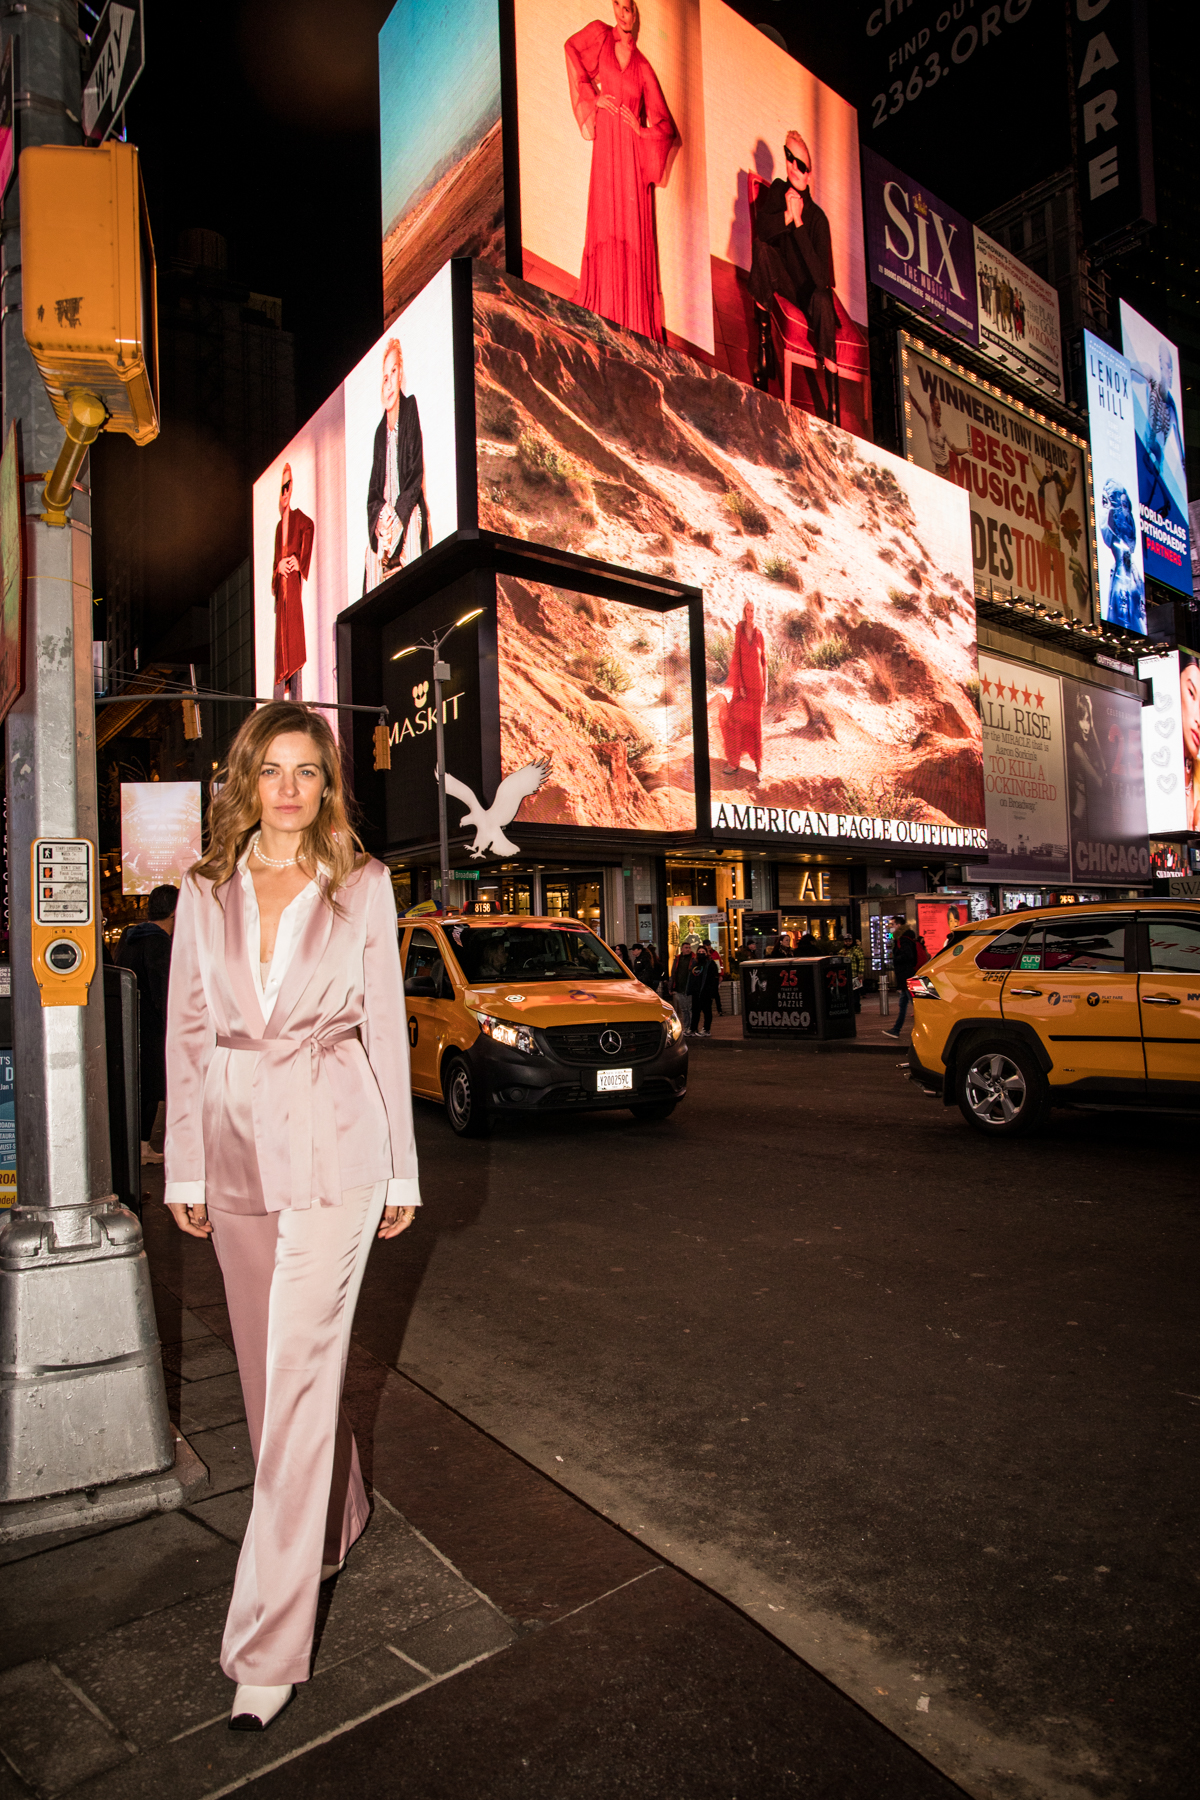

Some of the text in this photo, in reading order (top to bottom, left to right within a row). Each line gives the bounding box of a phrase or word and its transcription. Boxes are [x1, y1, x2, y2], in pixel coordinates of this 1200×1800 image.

[888, 0, 976, 73] FIND OU
[95, 13, 124, 111] WAY
[883, 181, 966, 300] SIX
[903, 262, 918, 283] THE
[920, 273, 952, 305] MUSICAL
[1028, 299, 1055, 325] THE PLAY
[1041, 319, 1059, 341] GOES
[1027, 321, 1059, 359] WRONG
[1090, 355, 1128, 399] LENOX
[916, 364, 1000, 434] WINNER!
[1001, 419, 1008, 438] 8
[1008, 417, 1033, 451] TONY
[1034, 432, 1069, 472] AWARDS
[1098, 384, 1124, 420] HILL
[969, 425, 1029, 485] BEST
[950, 449, 1053, 532] MUSICAL
[1139, 503, 1187, 541] WORLD-CLASS
[1139, 518, 1187, 555] ORTHOPAEDIC
[1146, 536, 1182, 567] PARTNERS
[388, 691, 465, 747] MASKIT
[980, 701, 1052, 741] ALL RISE
[991, 731, 1000, 742] the
[1001, 732, 1031, 749] MIRACLE
[1031, 740, 1043, 752] that
[1044, 742, 1049, 752] is
[995, 744, 1014, 757] Aaron
[1108, 723, 1143, 780] 25
[989, 755, 1046, 781] TO KILL A
[984, 774, 1057, 801] OCKINGBIRD
[1000, 798, 1008, 807] on
[716, 803, 830, 837] AMERICAN
[837, 814, 892, 841] EAGLE
[455, 871, 478, 880] Broadway
[1076, 841, 1149, 875] CHICAGO
[800, 871, 831, 900] AE
[474, 902, 491, 913] 8T58
[779, 969, 799, 986] 25
[748, 1011, 811, 1027] CHICAGO
[777, 1000, 803, 1008] DAZZLE
